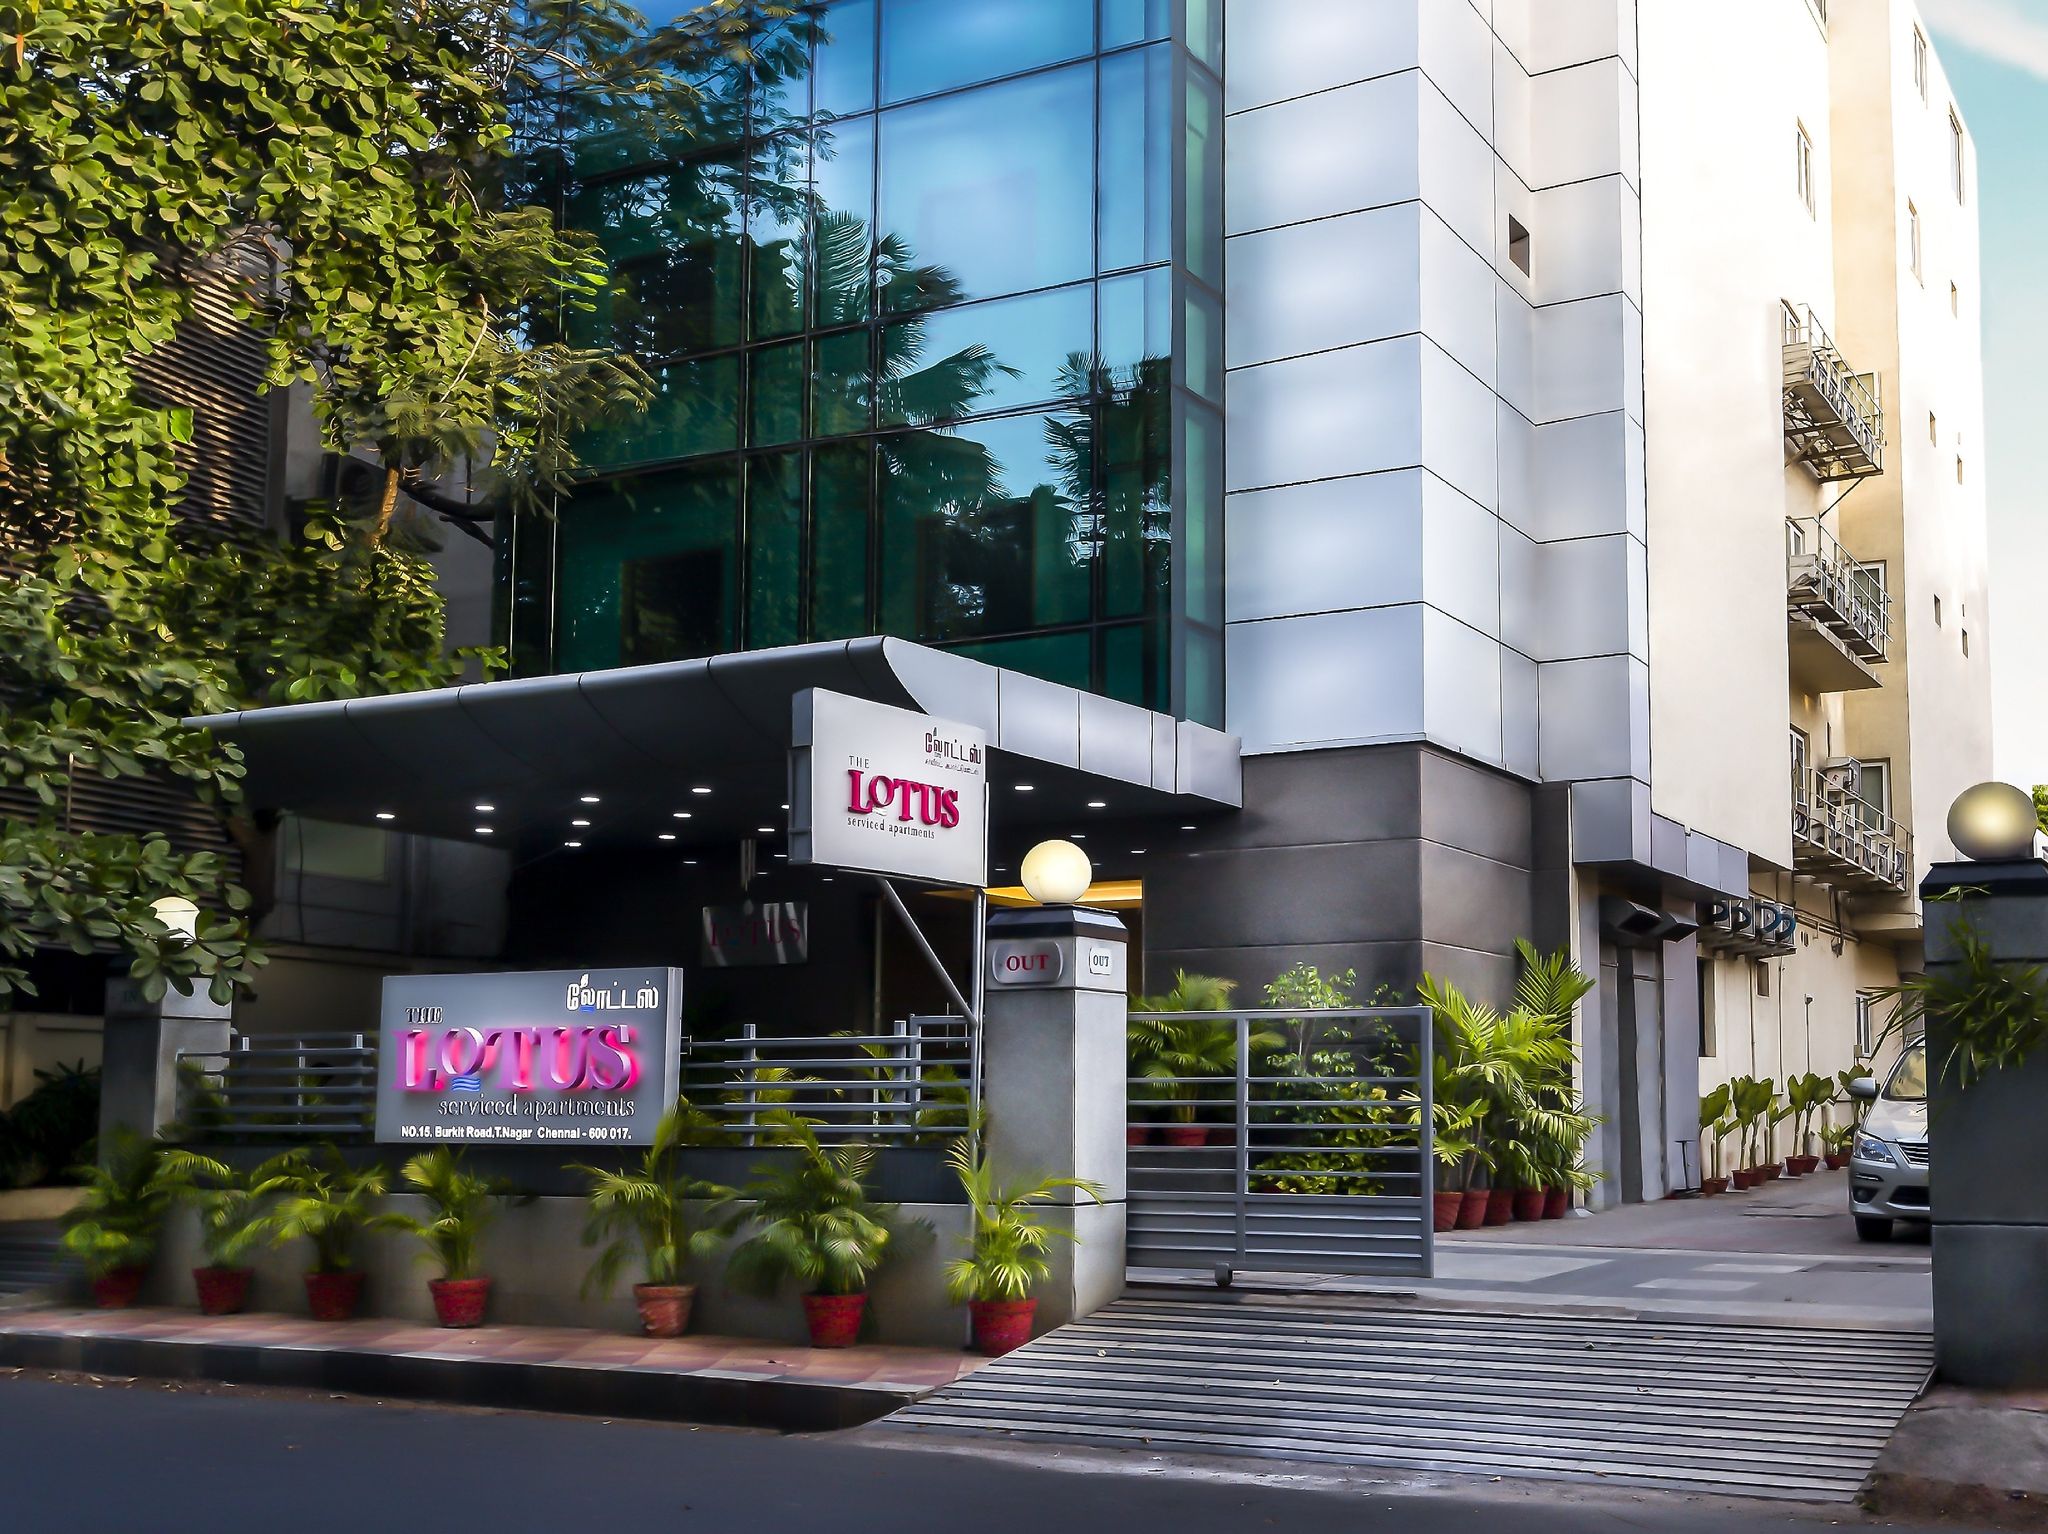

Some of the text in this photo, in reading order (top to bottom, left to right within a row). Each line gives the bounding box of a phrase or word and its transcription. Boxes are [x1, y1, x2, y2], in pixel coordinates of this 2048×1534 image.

[849, 755, 870, 769] THE
[847, 769, 960, 828] LOTUS
[847, 817, 935, 839] serviced apartments
[1006, 953, 1050, 971] OUT
[1092, 954, 1110, 967] OUT
[566, 980, 659, 1011] லோட்டஸ்
[405, 1006, 444, 1024] THE
[392, 1024, 638, 1091] LOTUS
[438, 1094, 636, 1121] serviced apartments
[435, 1125, 465, 1138] Burkit
[537, 1126, 580, 1139] Chennai
[588, 1127, 608, 1139] 600
[610, 1127, 632, 1140] 017.
